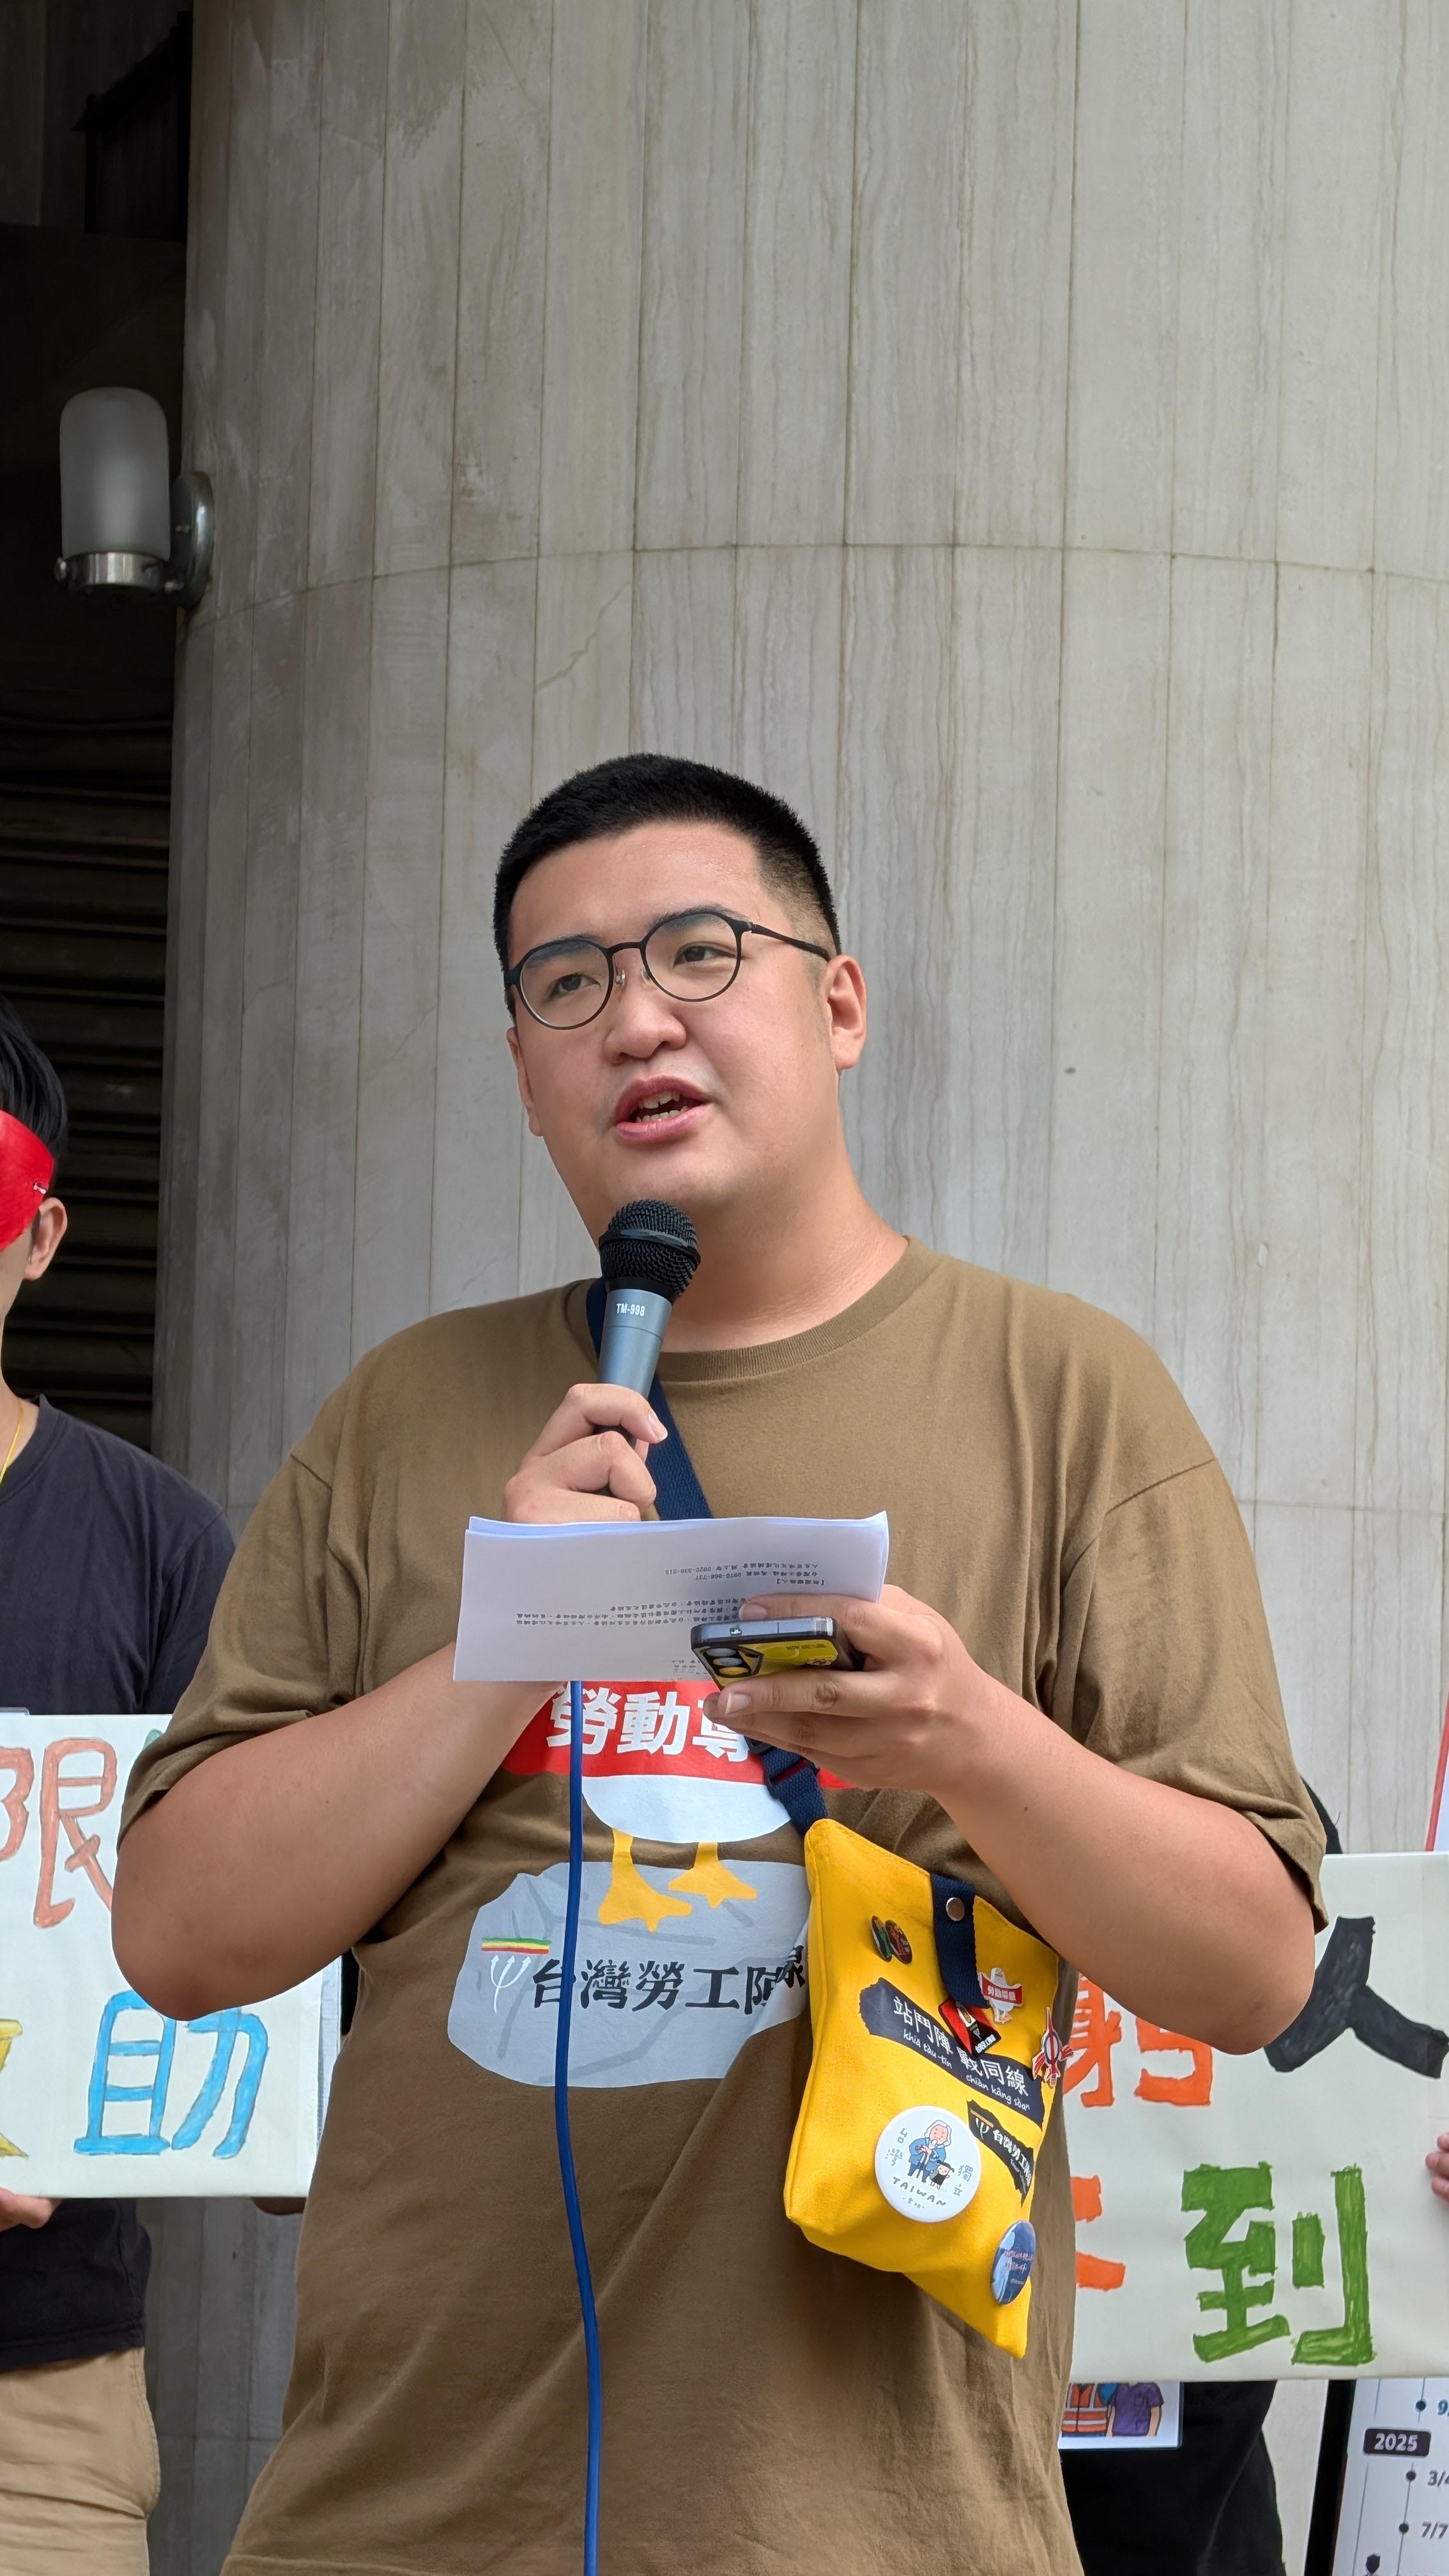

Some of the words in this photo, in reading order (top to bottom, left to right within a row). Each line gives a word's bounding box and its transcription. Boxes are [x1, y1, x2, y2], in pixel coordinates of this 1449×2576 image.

[892, 2176, 947, 2207] TAIWAN
[1374, 2433, 1418, 2452] 2025
[1421, 2521, 1448, 2540] 7/7
